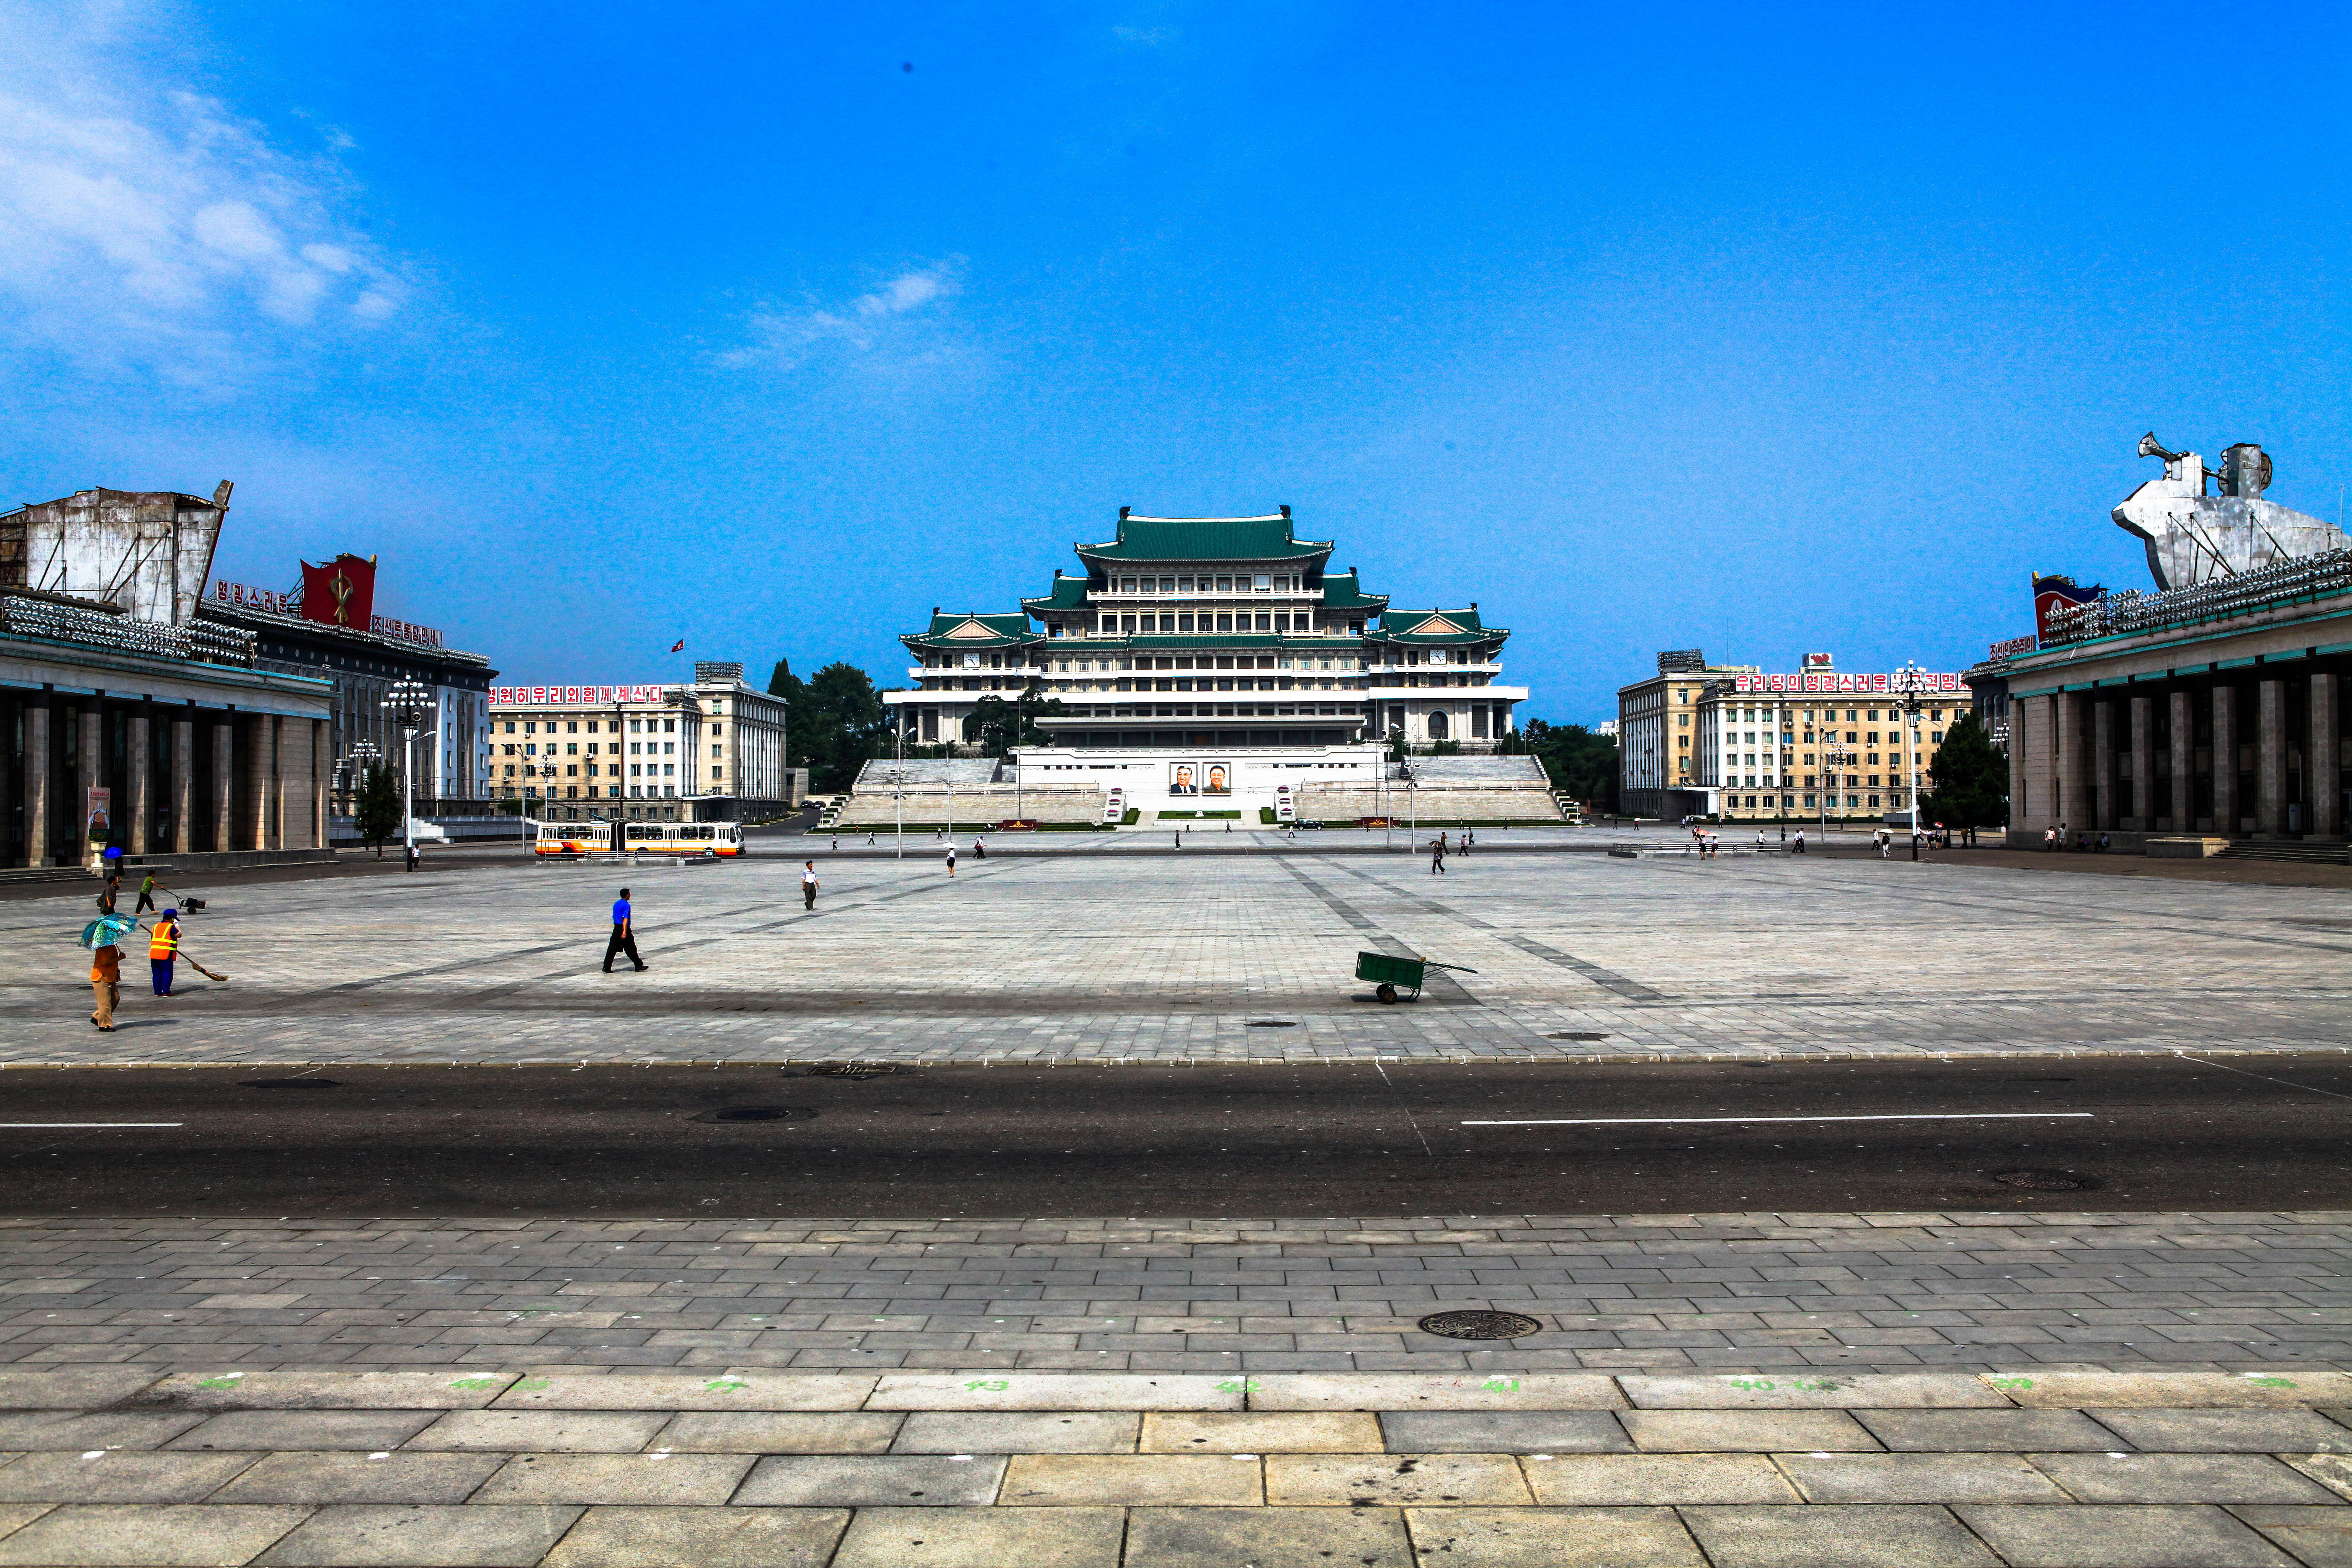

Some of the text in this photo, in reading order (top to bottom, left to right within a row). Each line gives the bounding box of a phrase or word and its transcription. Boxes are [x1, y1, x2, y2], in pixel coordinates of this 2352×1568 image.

[218, 581, 287, 613] 영광스러운
[1990, 637, 2033, 661] 조선민주주의
[963, 1380, 1009, 1391] 43
[1214, 1381, 1262, 1393] 42
[1480, 1380, 1519, 1393] 41
[1991, 1378, 2033, 1390] 39
